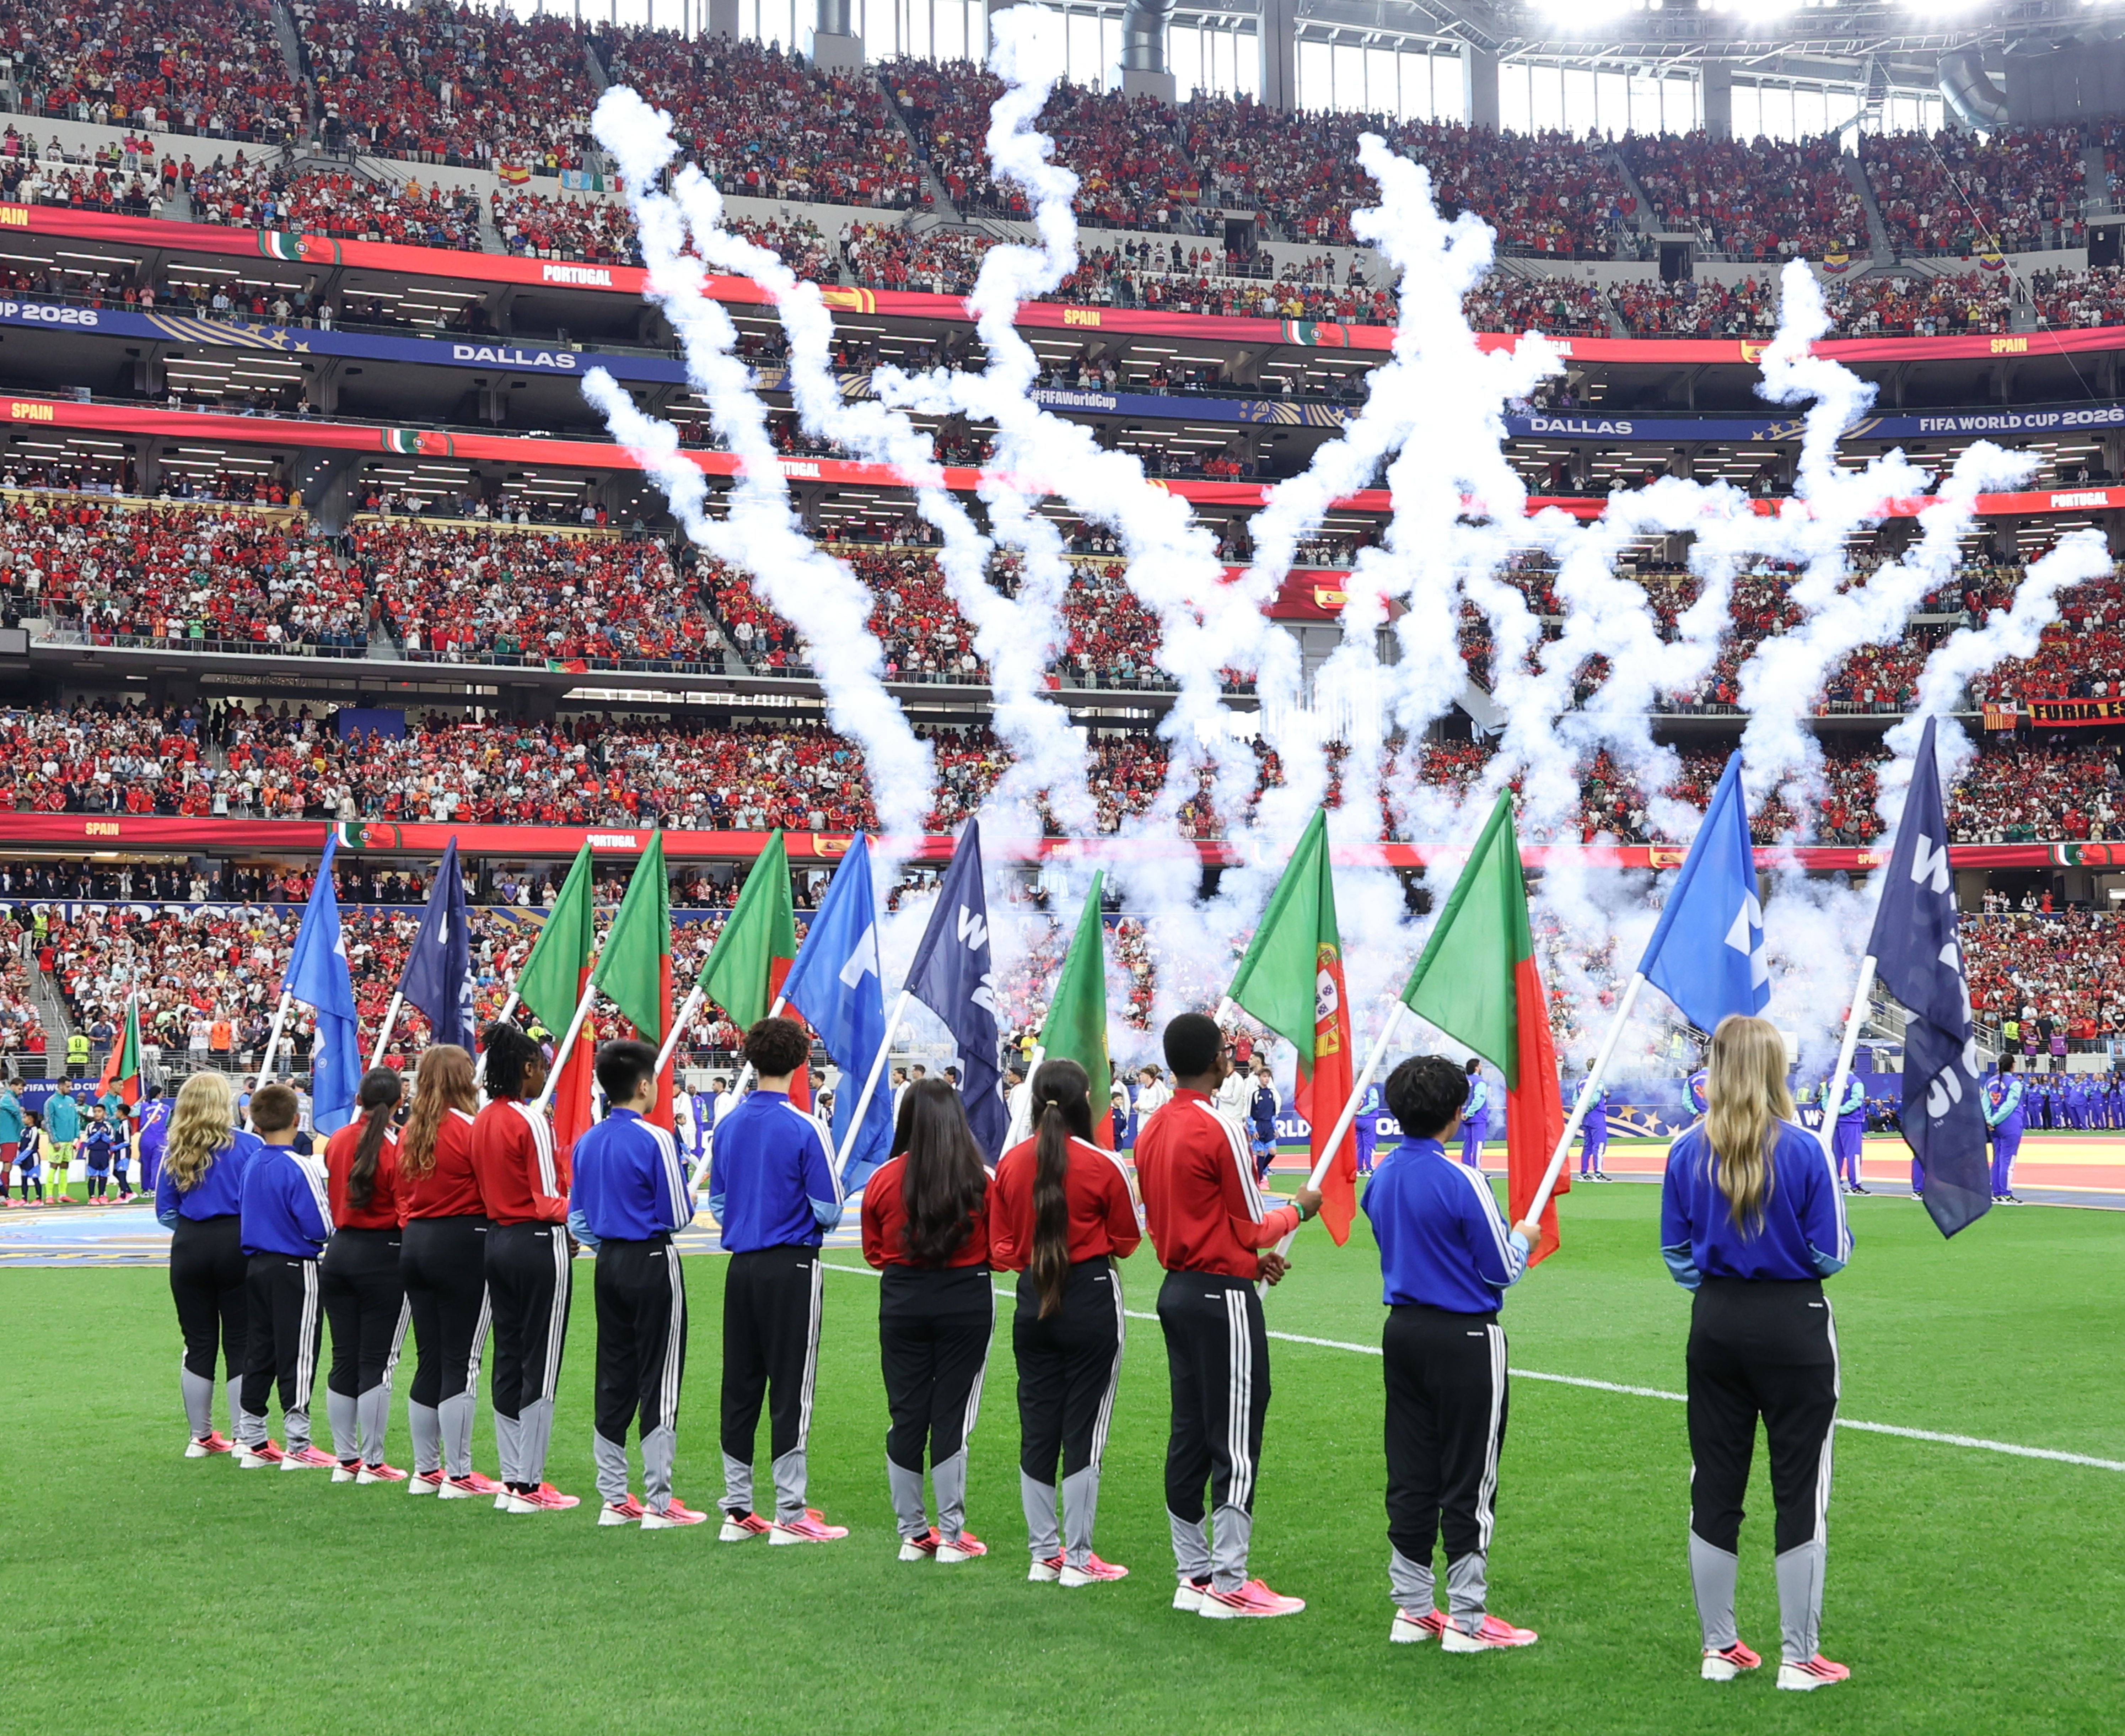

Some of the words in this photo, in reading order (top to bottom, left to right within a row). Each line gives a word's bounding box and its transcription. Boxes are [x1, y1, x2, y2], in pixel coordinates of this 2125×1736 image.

[0, 207, 28, 226] AIN
[543, 265, 612, 286] PORTUGAL
[0, 302, 18, 317] P
[22, 304, 98, 325] 2026
[1064, 309, 1101, 326] SPAIN
[1991, 338, 2027, 353] SPAIN
[453, 345, 576, 368] DALLAS
[1031, 389, 1116, 410] #FIFAWorldCup
[11, 403, 53, 421] SPAIN
[1920, 418, 1957, 431] FIFA
[1959, 415, 2022, 430] WORLD
[2024, 413, 2059, 427] CUP
[2062, 409, 2124, 425] 2026
[1531, 418, 1633, 435] DALLAS
[777, 460, 821, 478] RTUGAL
[2051, 492, 2108, 508] PORTUGAL
[2033, 704, 2102, 720] FURIA
[86, 822, 119, 836] SPAIN
[587, 835, 636, 847] PORTUGAL
[1052, 844, 1079, 856] SPAIN
[1858, 854, 1884, 864] SPAIN
[1277, 1120, 1312, 1137] RLD
